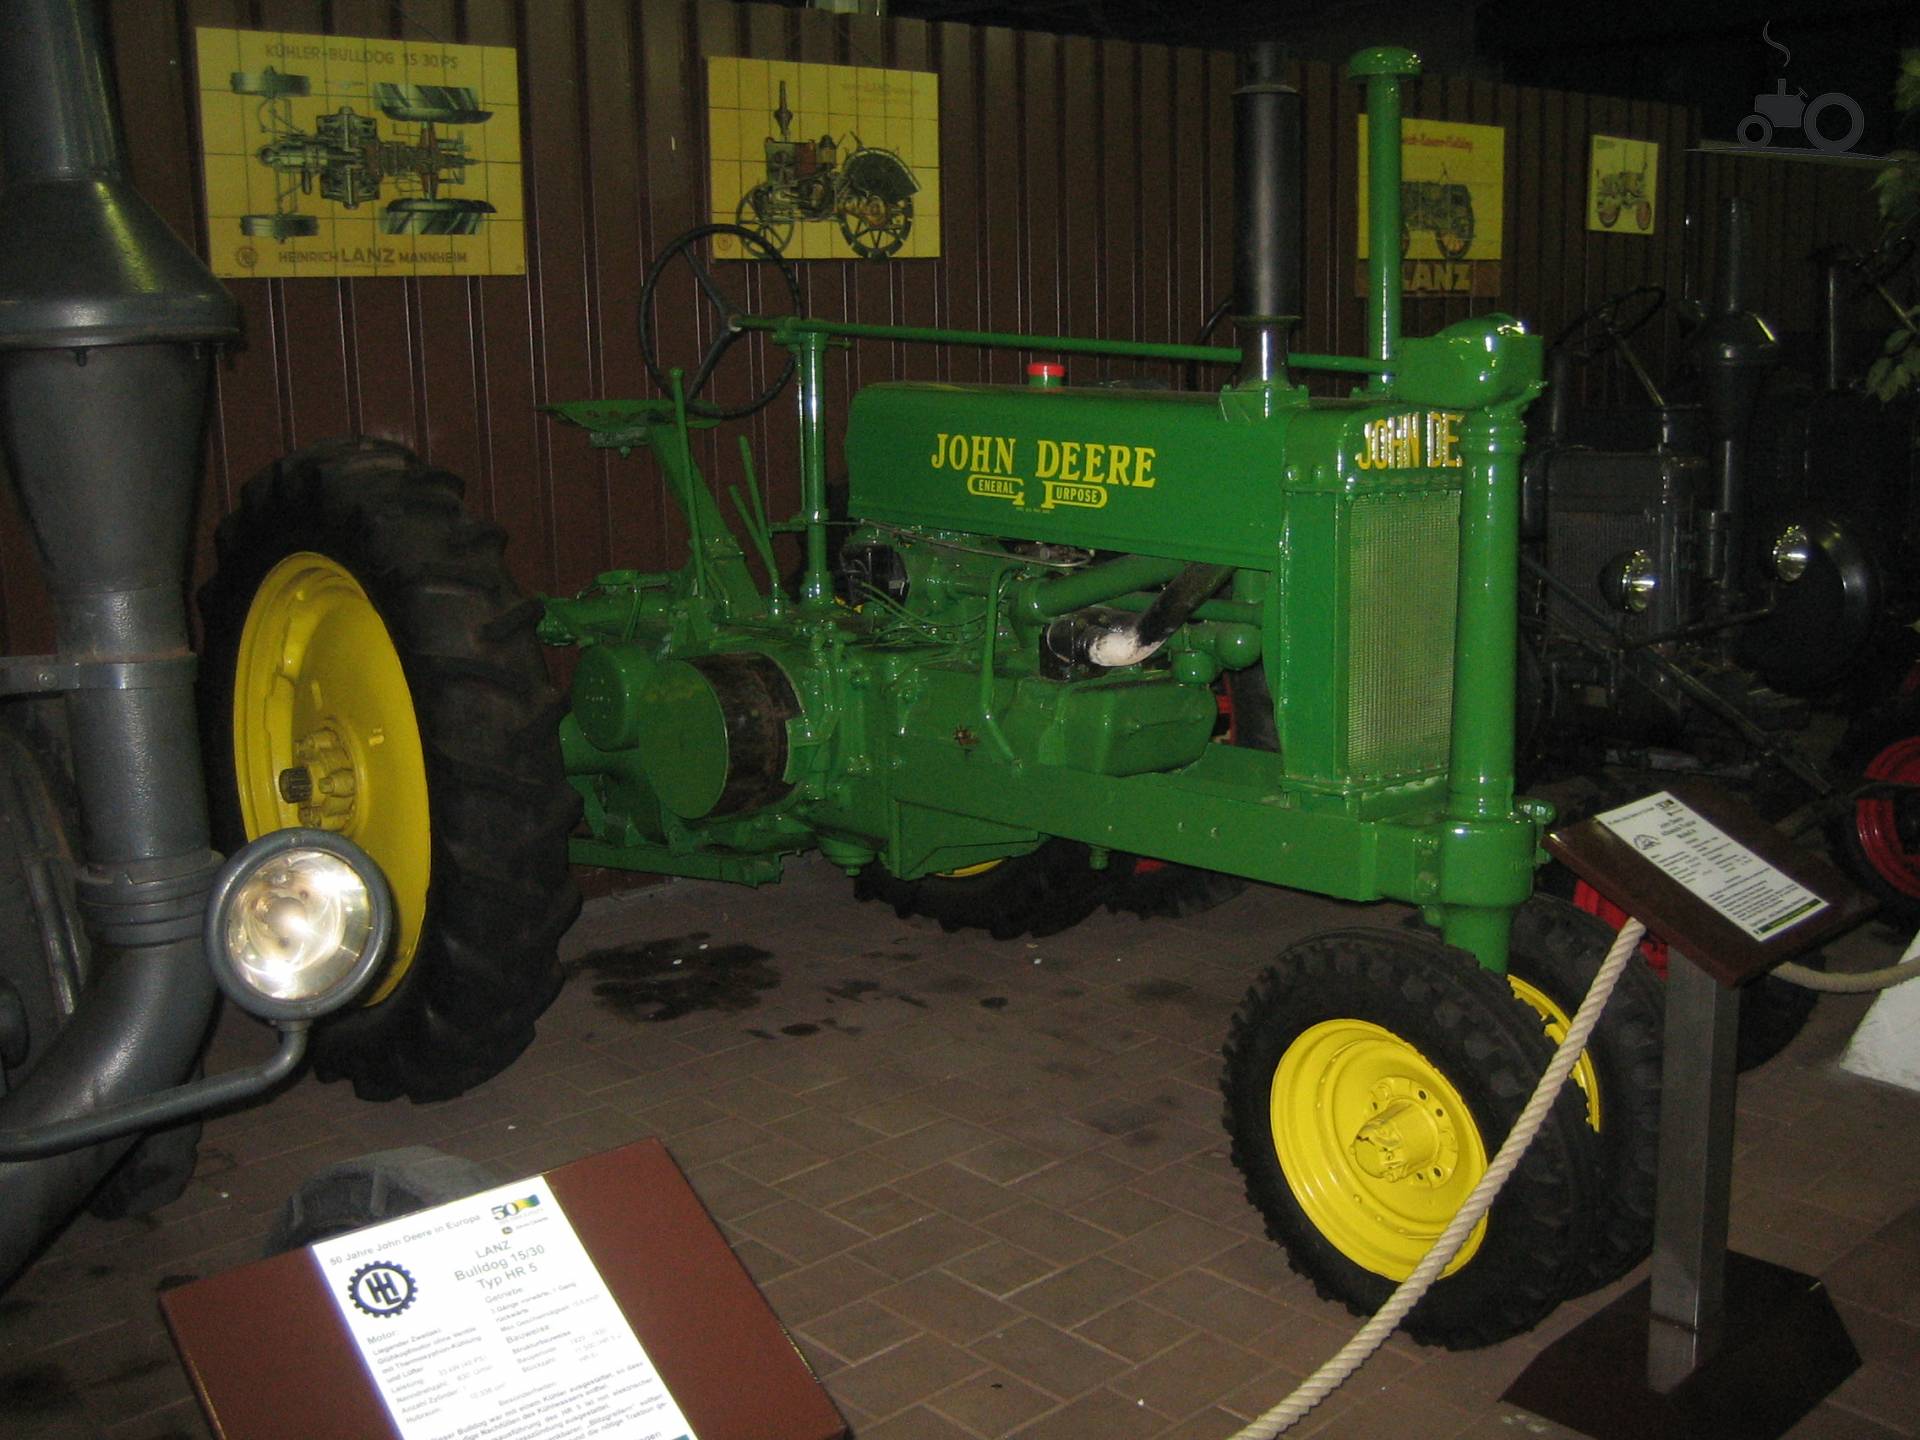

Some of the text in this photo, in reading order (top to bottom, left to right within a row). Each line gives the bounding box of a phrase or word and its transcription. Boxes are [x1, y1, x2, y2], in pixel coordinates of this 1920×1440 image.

[279, 248, 467, 264] HEINRICH LANZ MANNHEIM
[1355, 411, 1420, 470] JOHN
[931, 433, 1157, 488] JOHN DEERE
[346, 1248, 373, 1260] Jahre
[376, 1239, 401, 1251] John
[402, 1229, 432, 1242] Deere
[445, 1214, 480, 1229] Europa
[475, 1239, 511, 1258] LANZ
[453, 1244, 544, 1280] Bulldog 15/30
[476, 1262, 537, 1289] Typ HR 5
